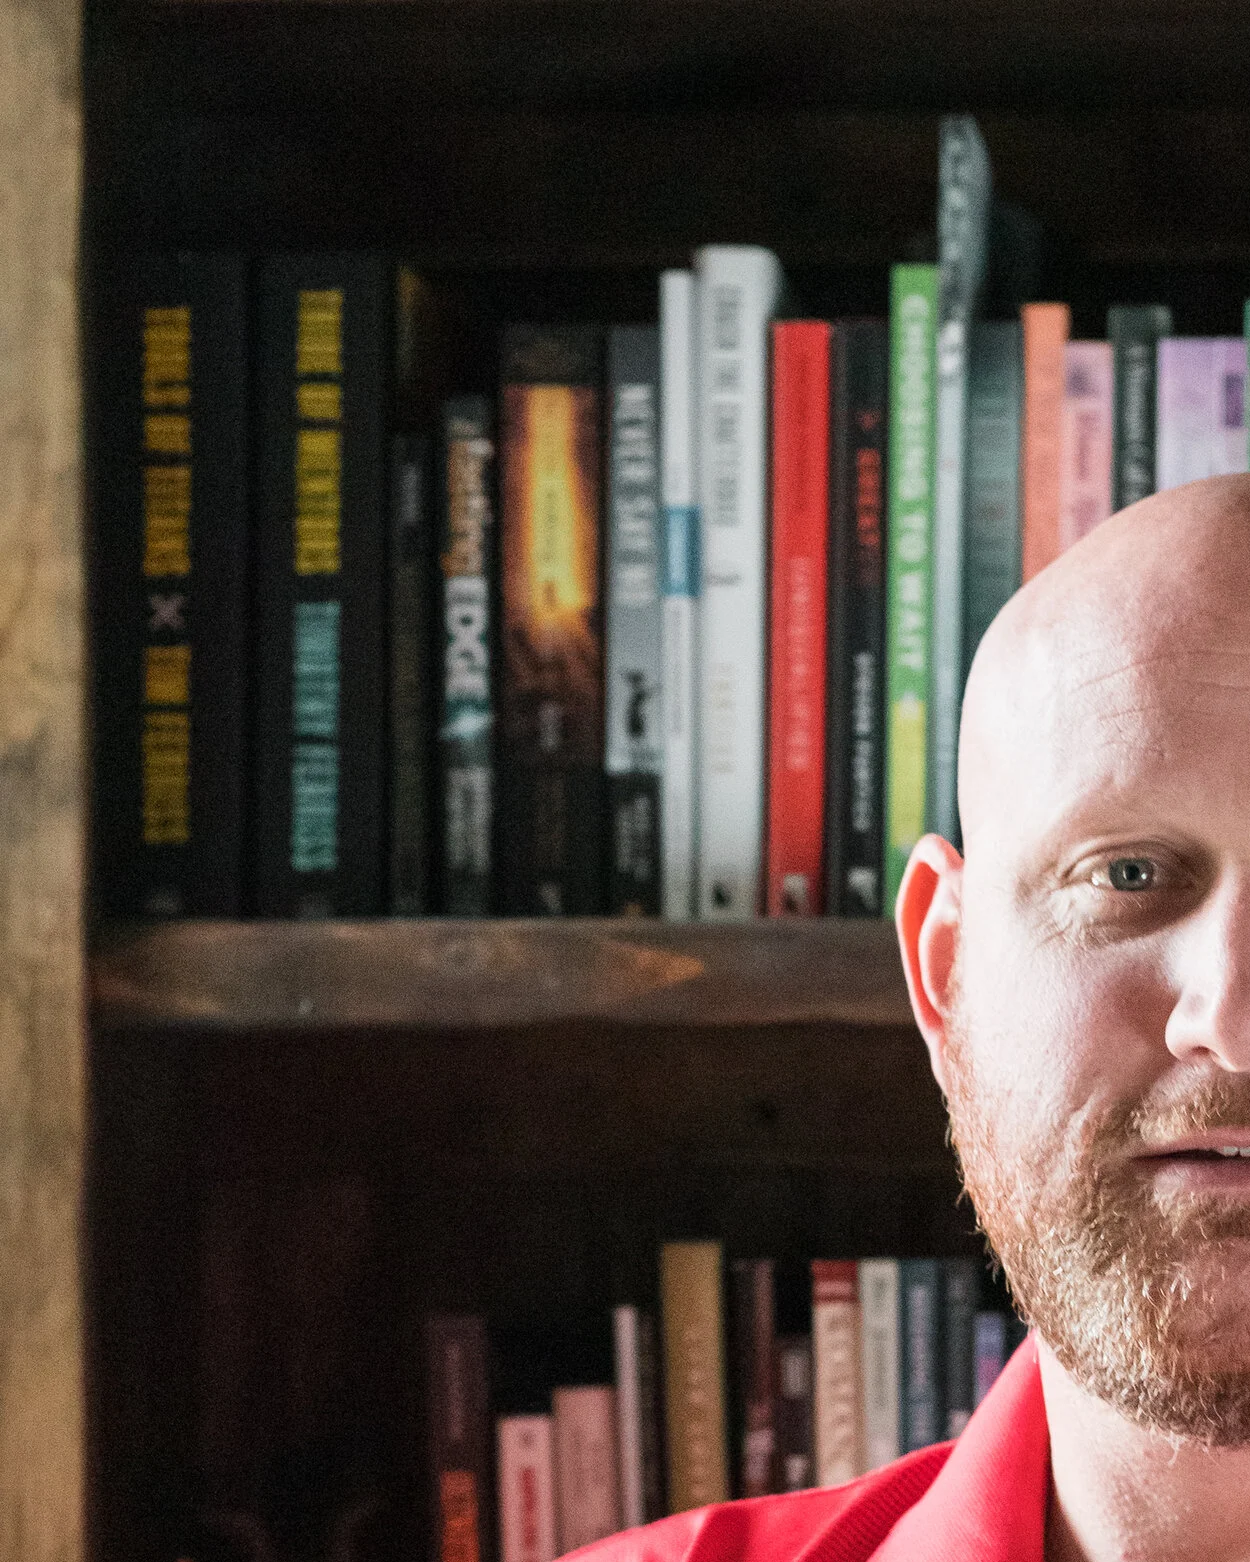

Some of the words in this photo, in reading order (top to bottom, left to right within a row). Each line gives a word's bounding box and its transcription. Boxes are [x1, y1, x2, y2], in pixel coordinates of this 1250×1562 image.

[613, 383, 657, 483] NEVER
[898, 293, 931, 499] CHOOSING
[613, 494, 657, 551] SAY
[897, 506, 928, 560] TO
[613, 562, 657, 607] NO
[895, 571, 927, 669] WAIT
[444, 577, 488, 702] EDGE
